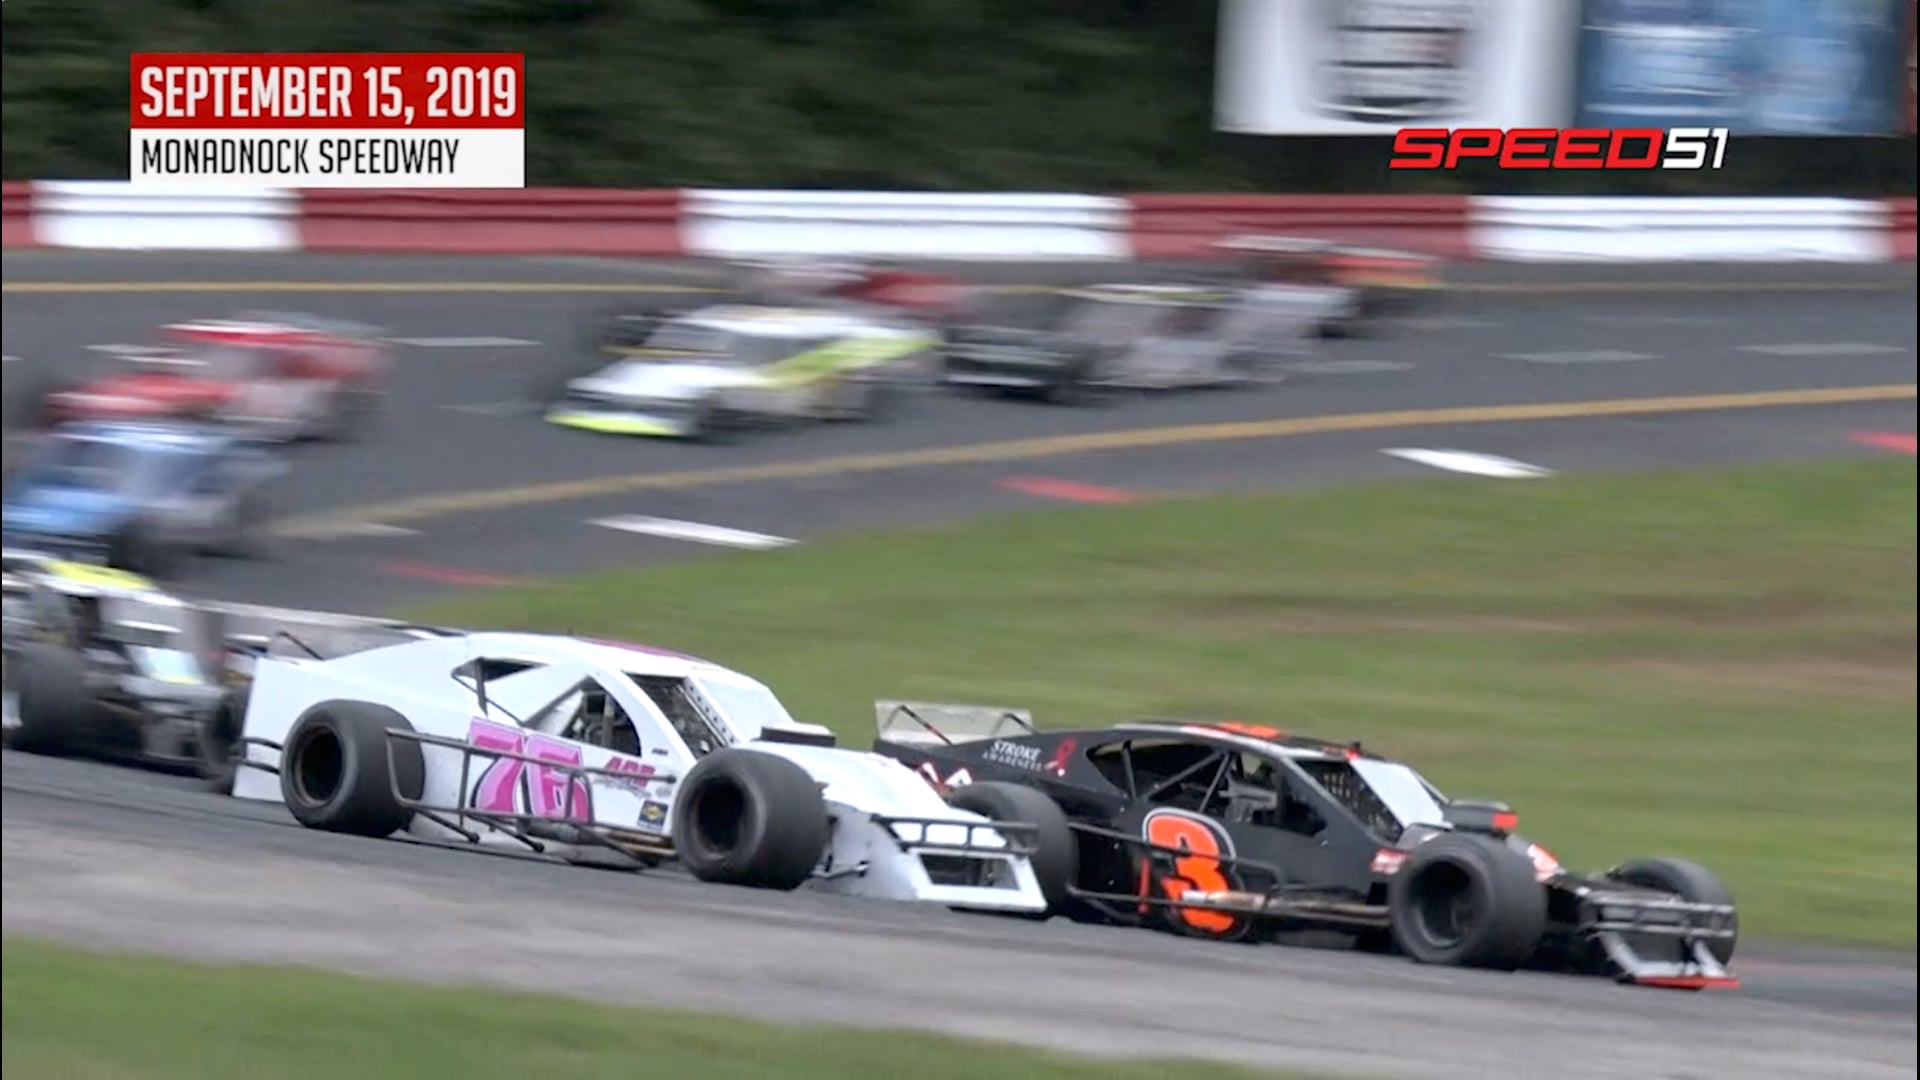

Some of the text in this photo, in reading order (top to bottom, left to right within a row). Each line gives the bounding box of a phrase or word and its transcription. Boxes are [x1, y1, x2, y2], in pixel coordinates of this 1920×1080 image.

[468, 716, 593, 824] 76
[991, 740, 1041, 761] STROKE
[1144, 808, 1238, 936] 3
